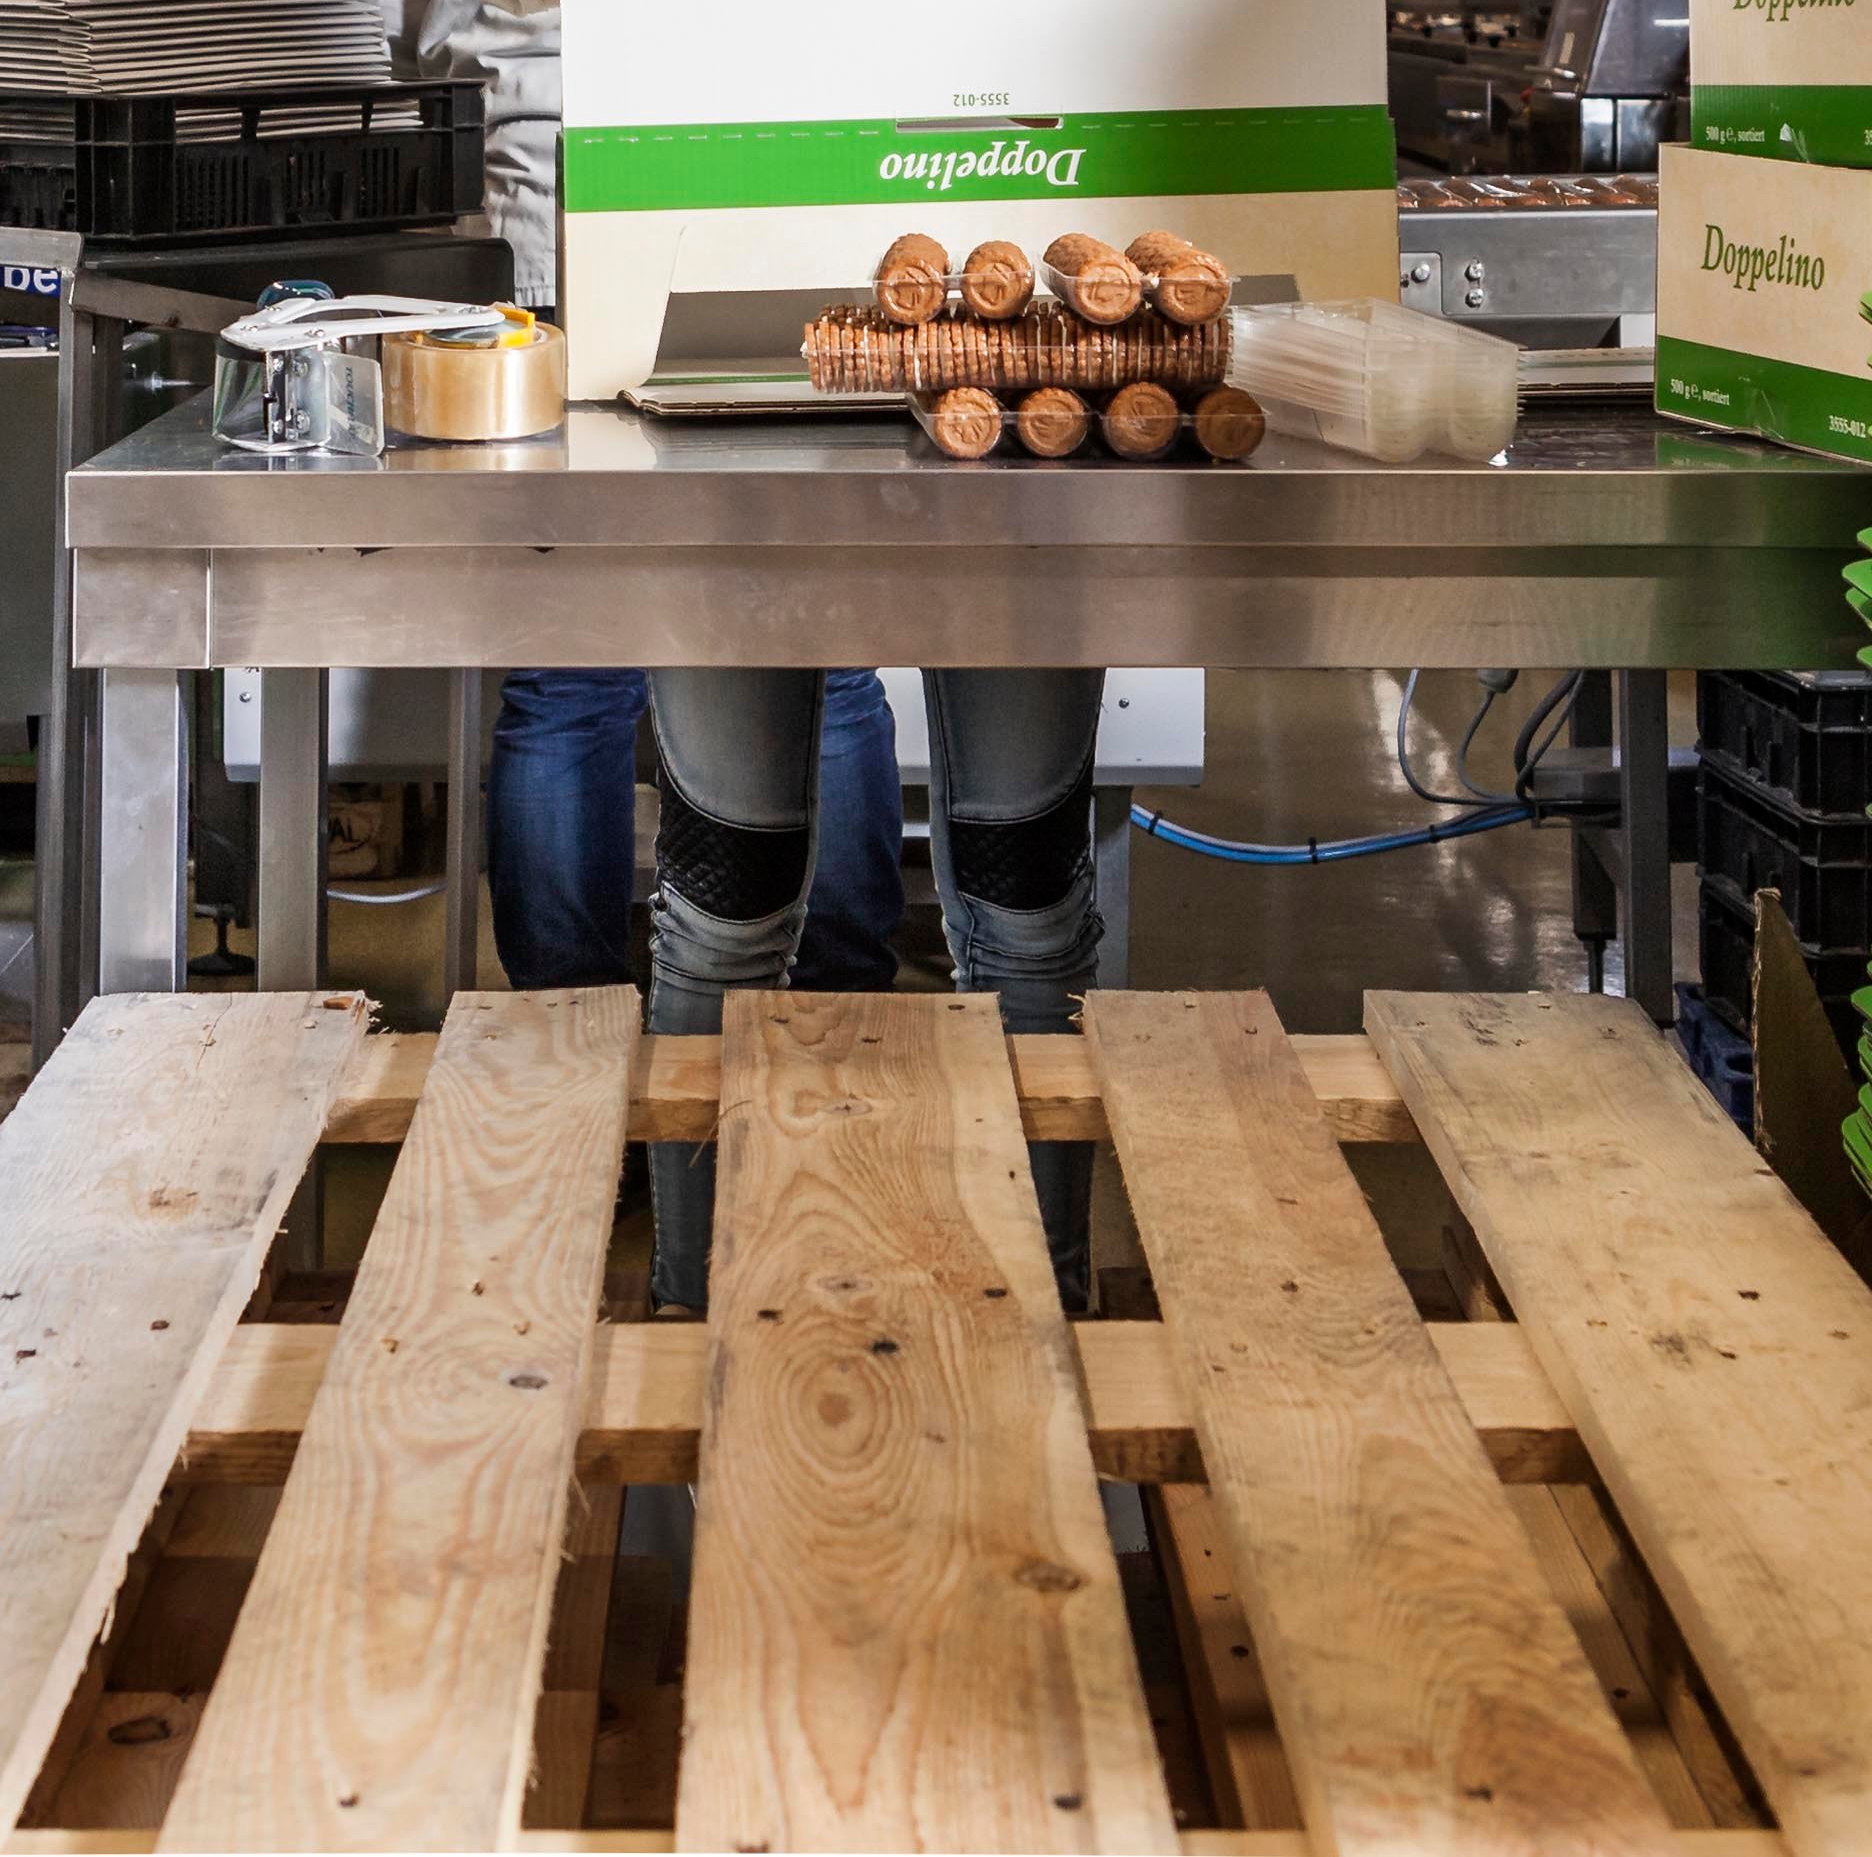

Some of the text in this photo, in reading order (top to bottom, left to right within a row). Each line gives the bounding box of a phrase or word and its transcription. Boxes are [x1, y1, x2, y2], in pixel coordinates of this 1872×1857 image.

[953, 93, 1009, 107] 3555-012
[1706, 126, 1720, 141] 500
[1737, 127, 1765, 142] sortiert
[880, 140, 1087, 191] Doppelino
[1701, 224, 1825, 292] Doppelino
[1670, 379, 1683, 395] 500
[1702, 388, 1730, 406] sortiert
[1829, 415, 1866, 438] 3555-012
